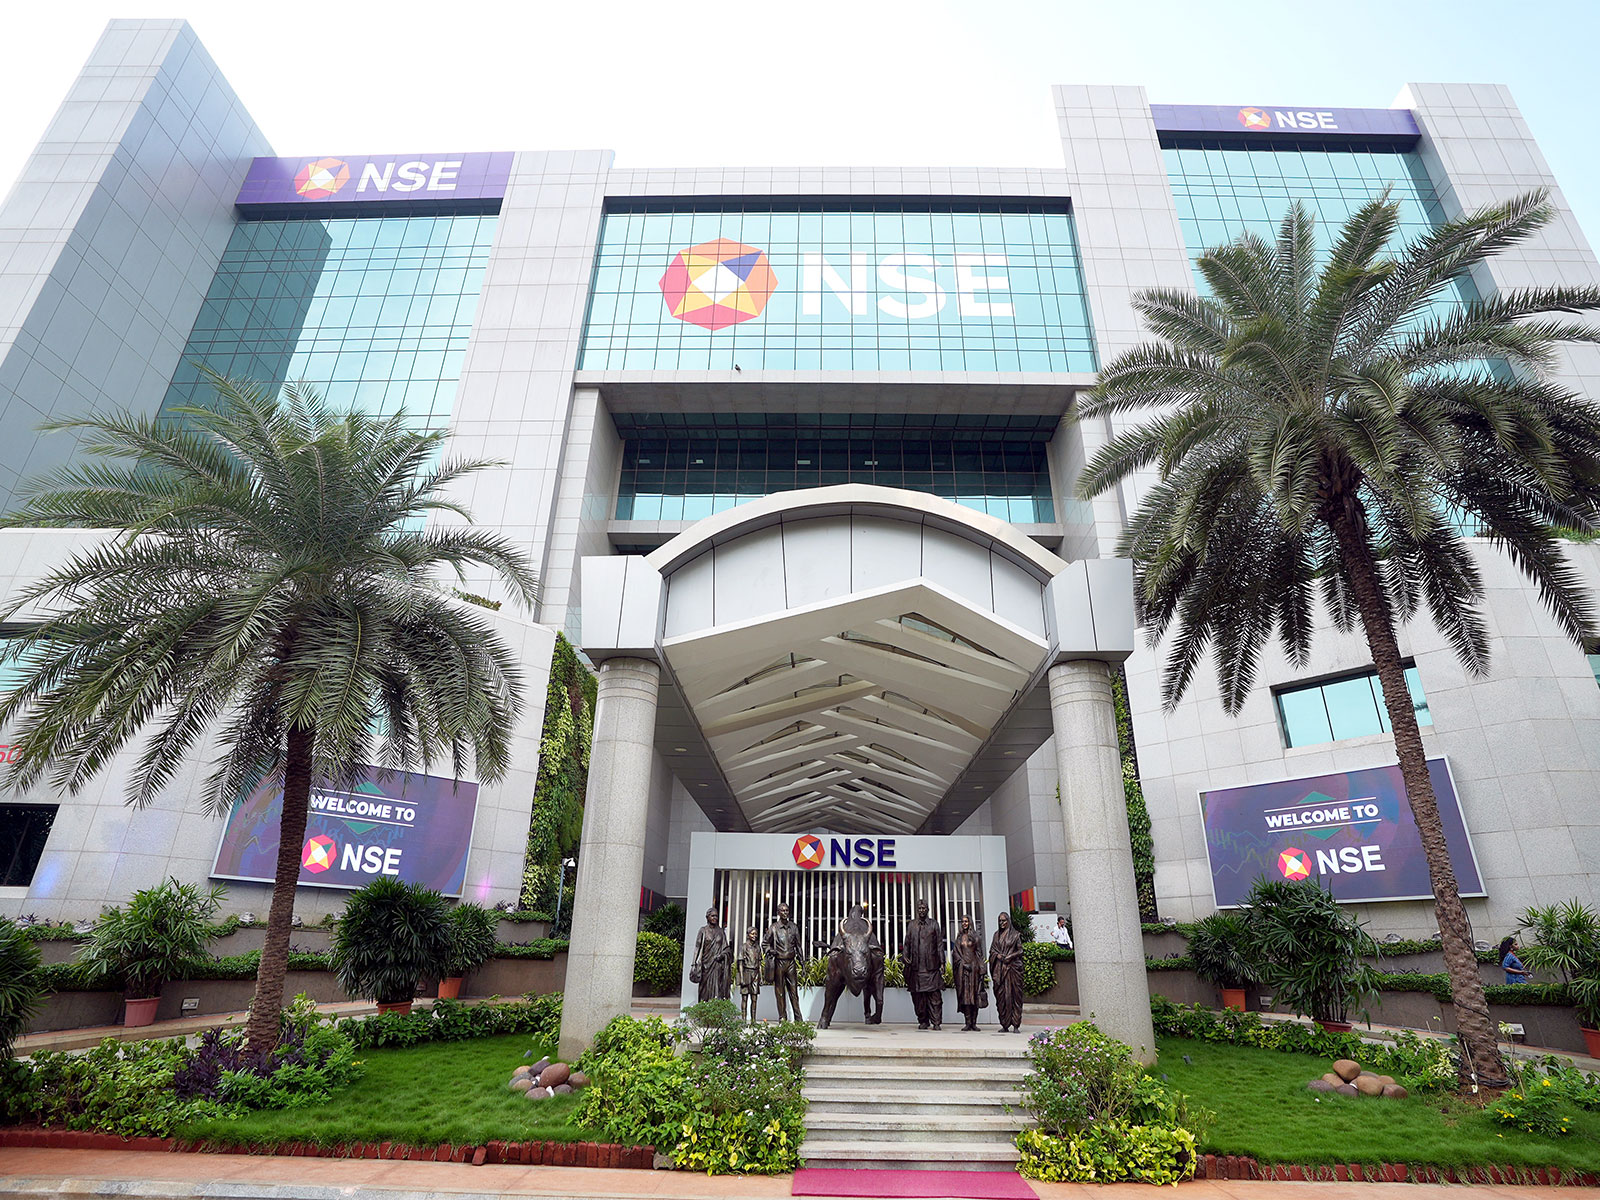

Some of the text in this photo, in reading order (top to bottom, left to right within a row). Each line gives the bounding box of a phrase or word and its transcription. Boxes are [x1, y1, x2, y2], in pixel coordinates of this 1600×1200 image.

[1274, 110, 1339, 130] NSE
[356, 160, 463, 193] NSE
[802, 250, 1017, 320] NSE
[310, 793, 416, 822] WELCOME TO
[1264, 803, 1379, 828] WELCOME TO
[340, 843, 403, 876] NSE
[830, 838, 897, 868] NSE
[1315, 844, 1386, 875] NSE
